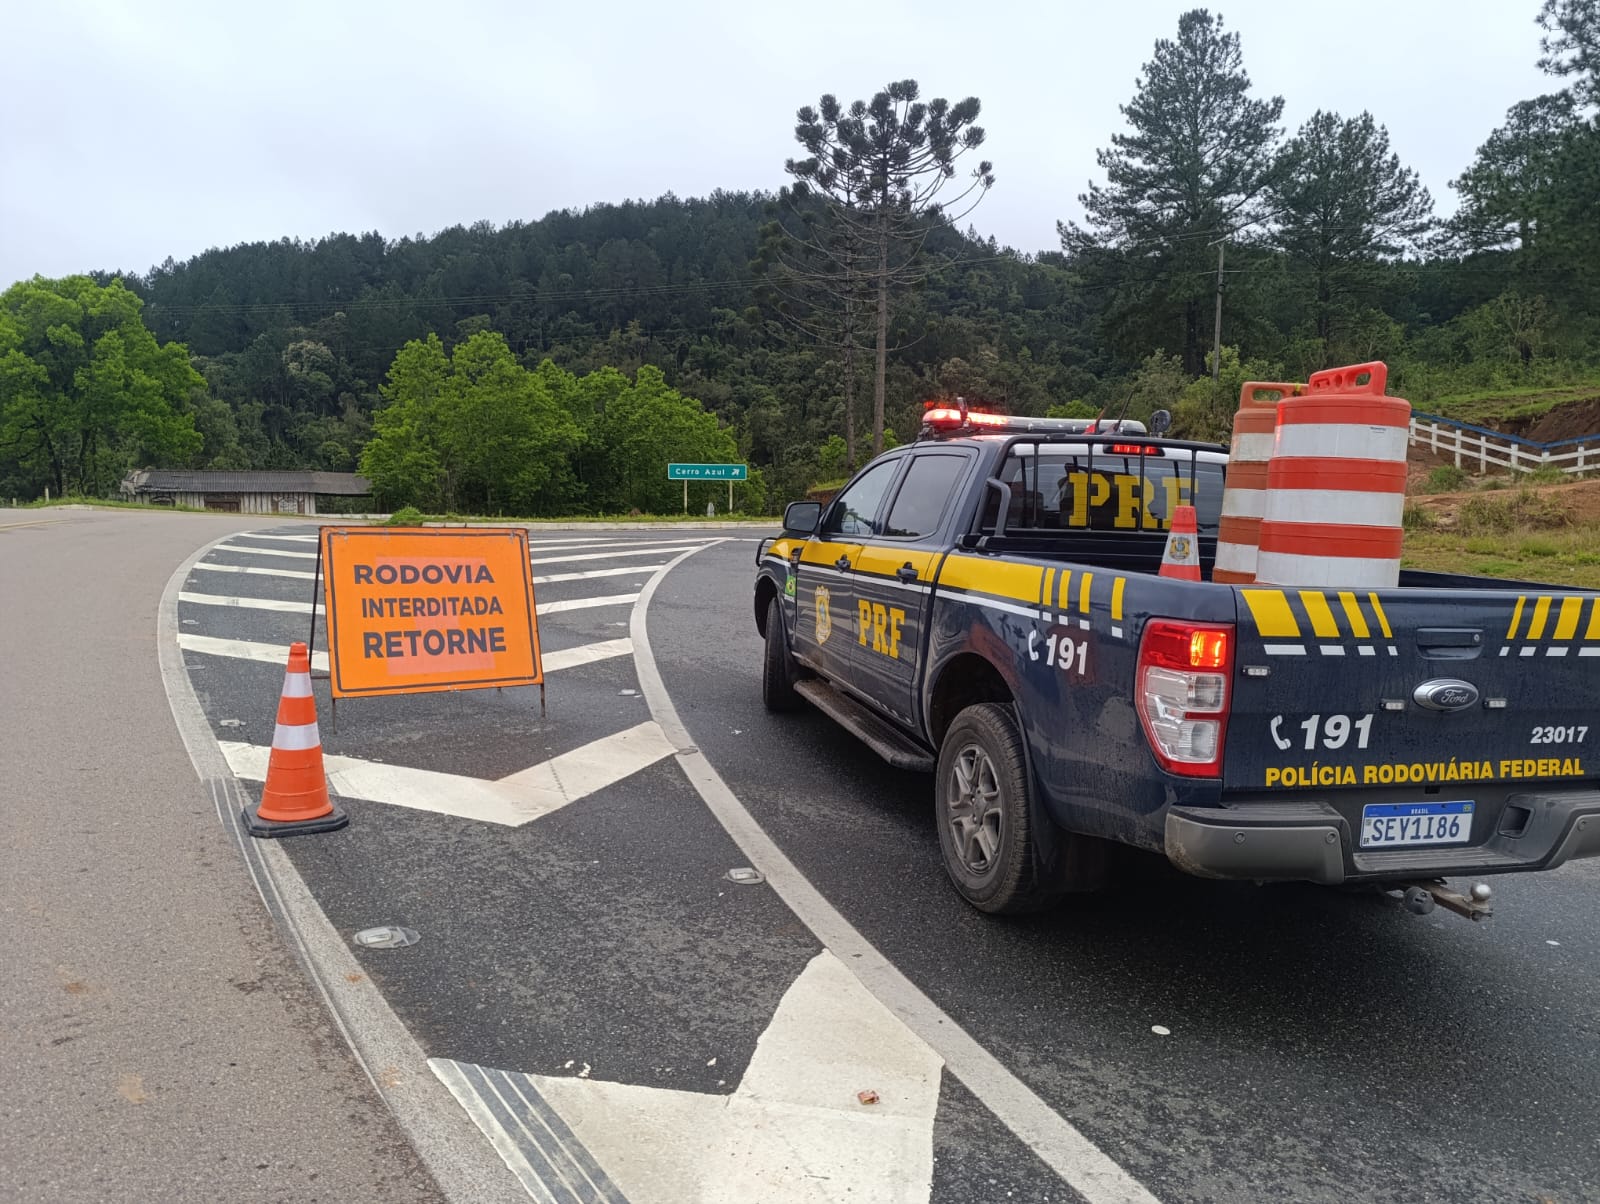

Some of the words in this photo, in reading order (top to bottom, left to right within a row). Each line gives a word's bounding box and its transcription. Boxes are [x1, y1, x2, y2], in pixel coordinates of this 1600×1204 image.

[1068, 472, 1199, 529] PRF
[353, 564, 495, 585] RODOVIA
[361, 596, 503, 618] INTERDITADA
[363, 627, 507, 659] RETORNE
[858, 599, 905, 659] PRF
[1046, 633, 1088, 675] 191
[1440, 689, 1469, 703] Ford
[1301, 713, 1374, 750] 191
[1530, 726, 1588, 744] 23017
[1265, 761, 1357, 787] POLÍCIA
[1363, 757, 1494, 784] RODOVIÁRIA
[1500, 758, 1585, 778] FEDERAL
[1371, 815, 1460, 842] SEY1I86
